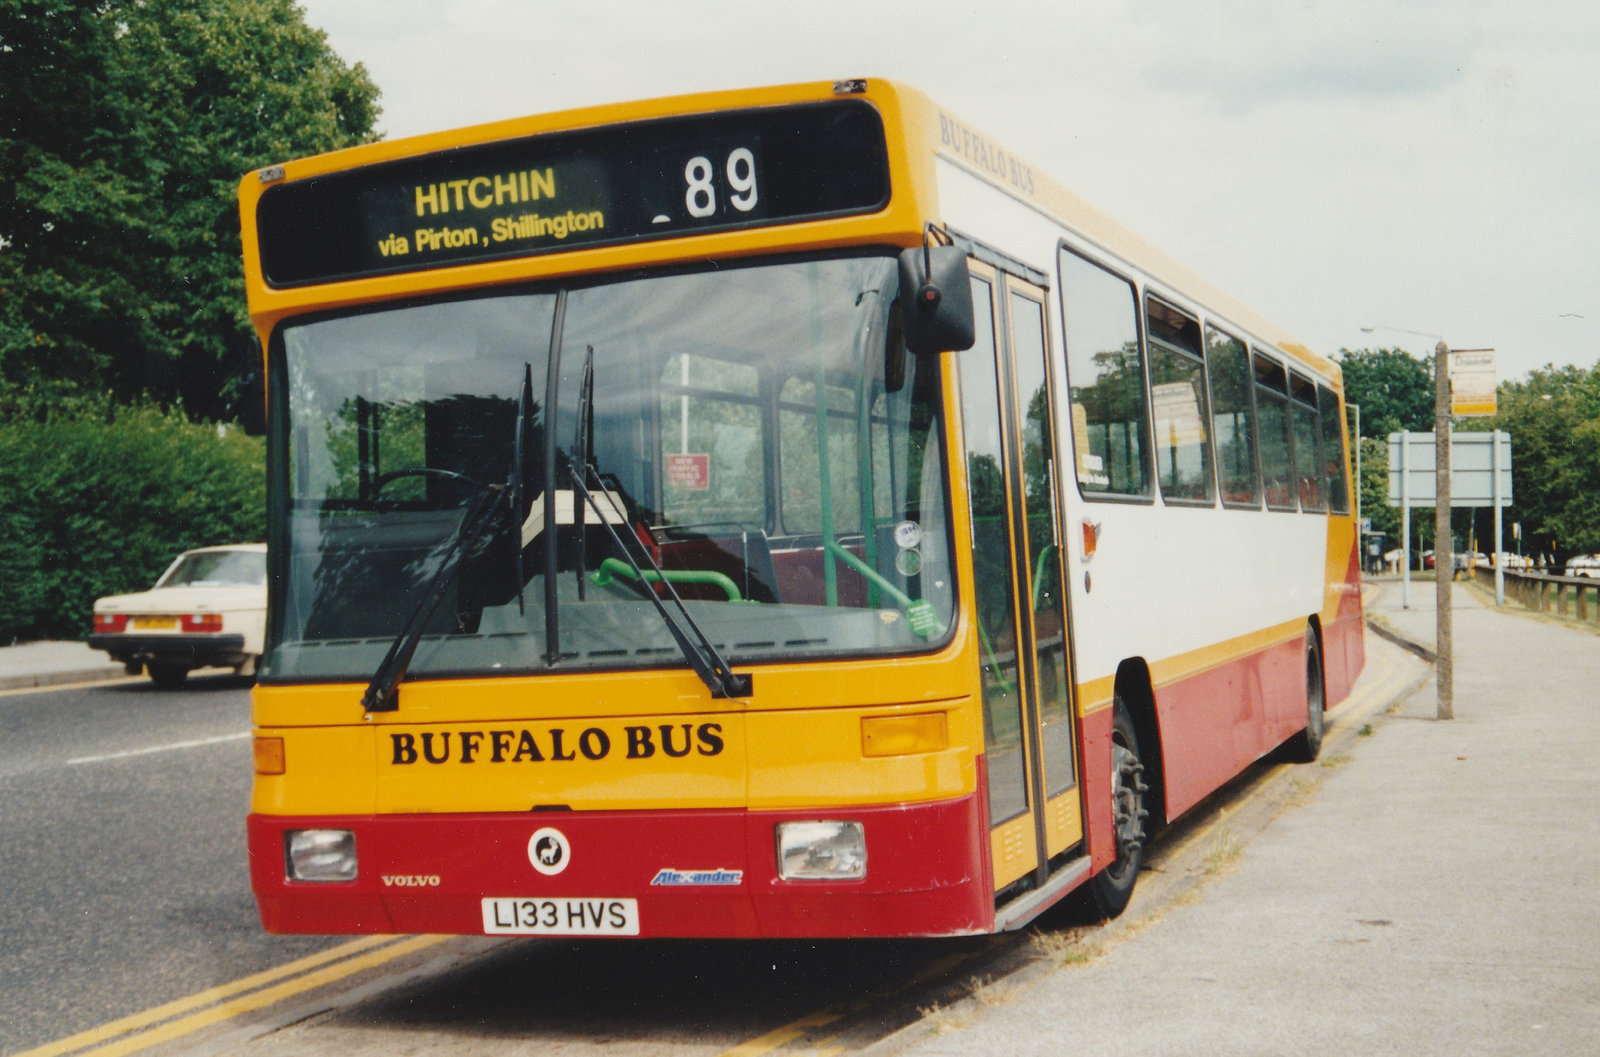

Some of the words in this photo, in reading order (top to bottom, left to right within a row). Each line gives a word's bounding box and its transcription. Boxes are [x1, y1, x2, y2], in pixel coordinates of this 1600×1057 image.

[939, 113, 1006, 178] BUFFALO
[1009, 157, 1034, 195] BUS
[415, 168, 555, 216] HITCHIN
[685, 147, 758, 218] 89
[378, 233, 409, 257] via
[491, 210, 604, 239] Shillington
[391, 727, 611, 765] BUFFALO
[624, 723, 724, 759] BUS
[381, 875, 440, 887] VOLVO
[494, 902, 558, 928] L133
[567, 902, 626, 928] HVS
